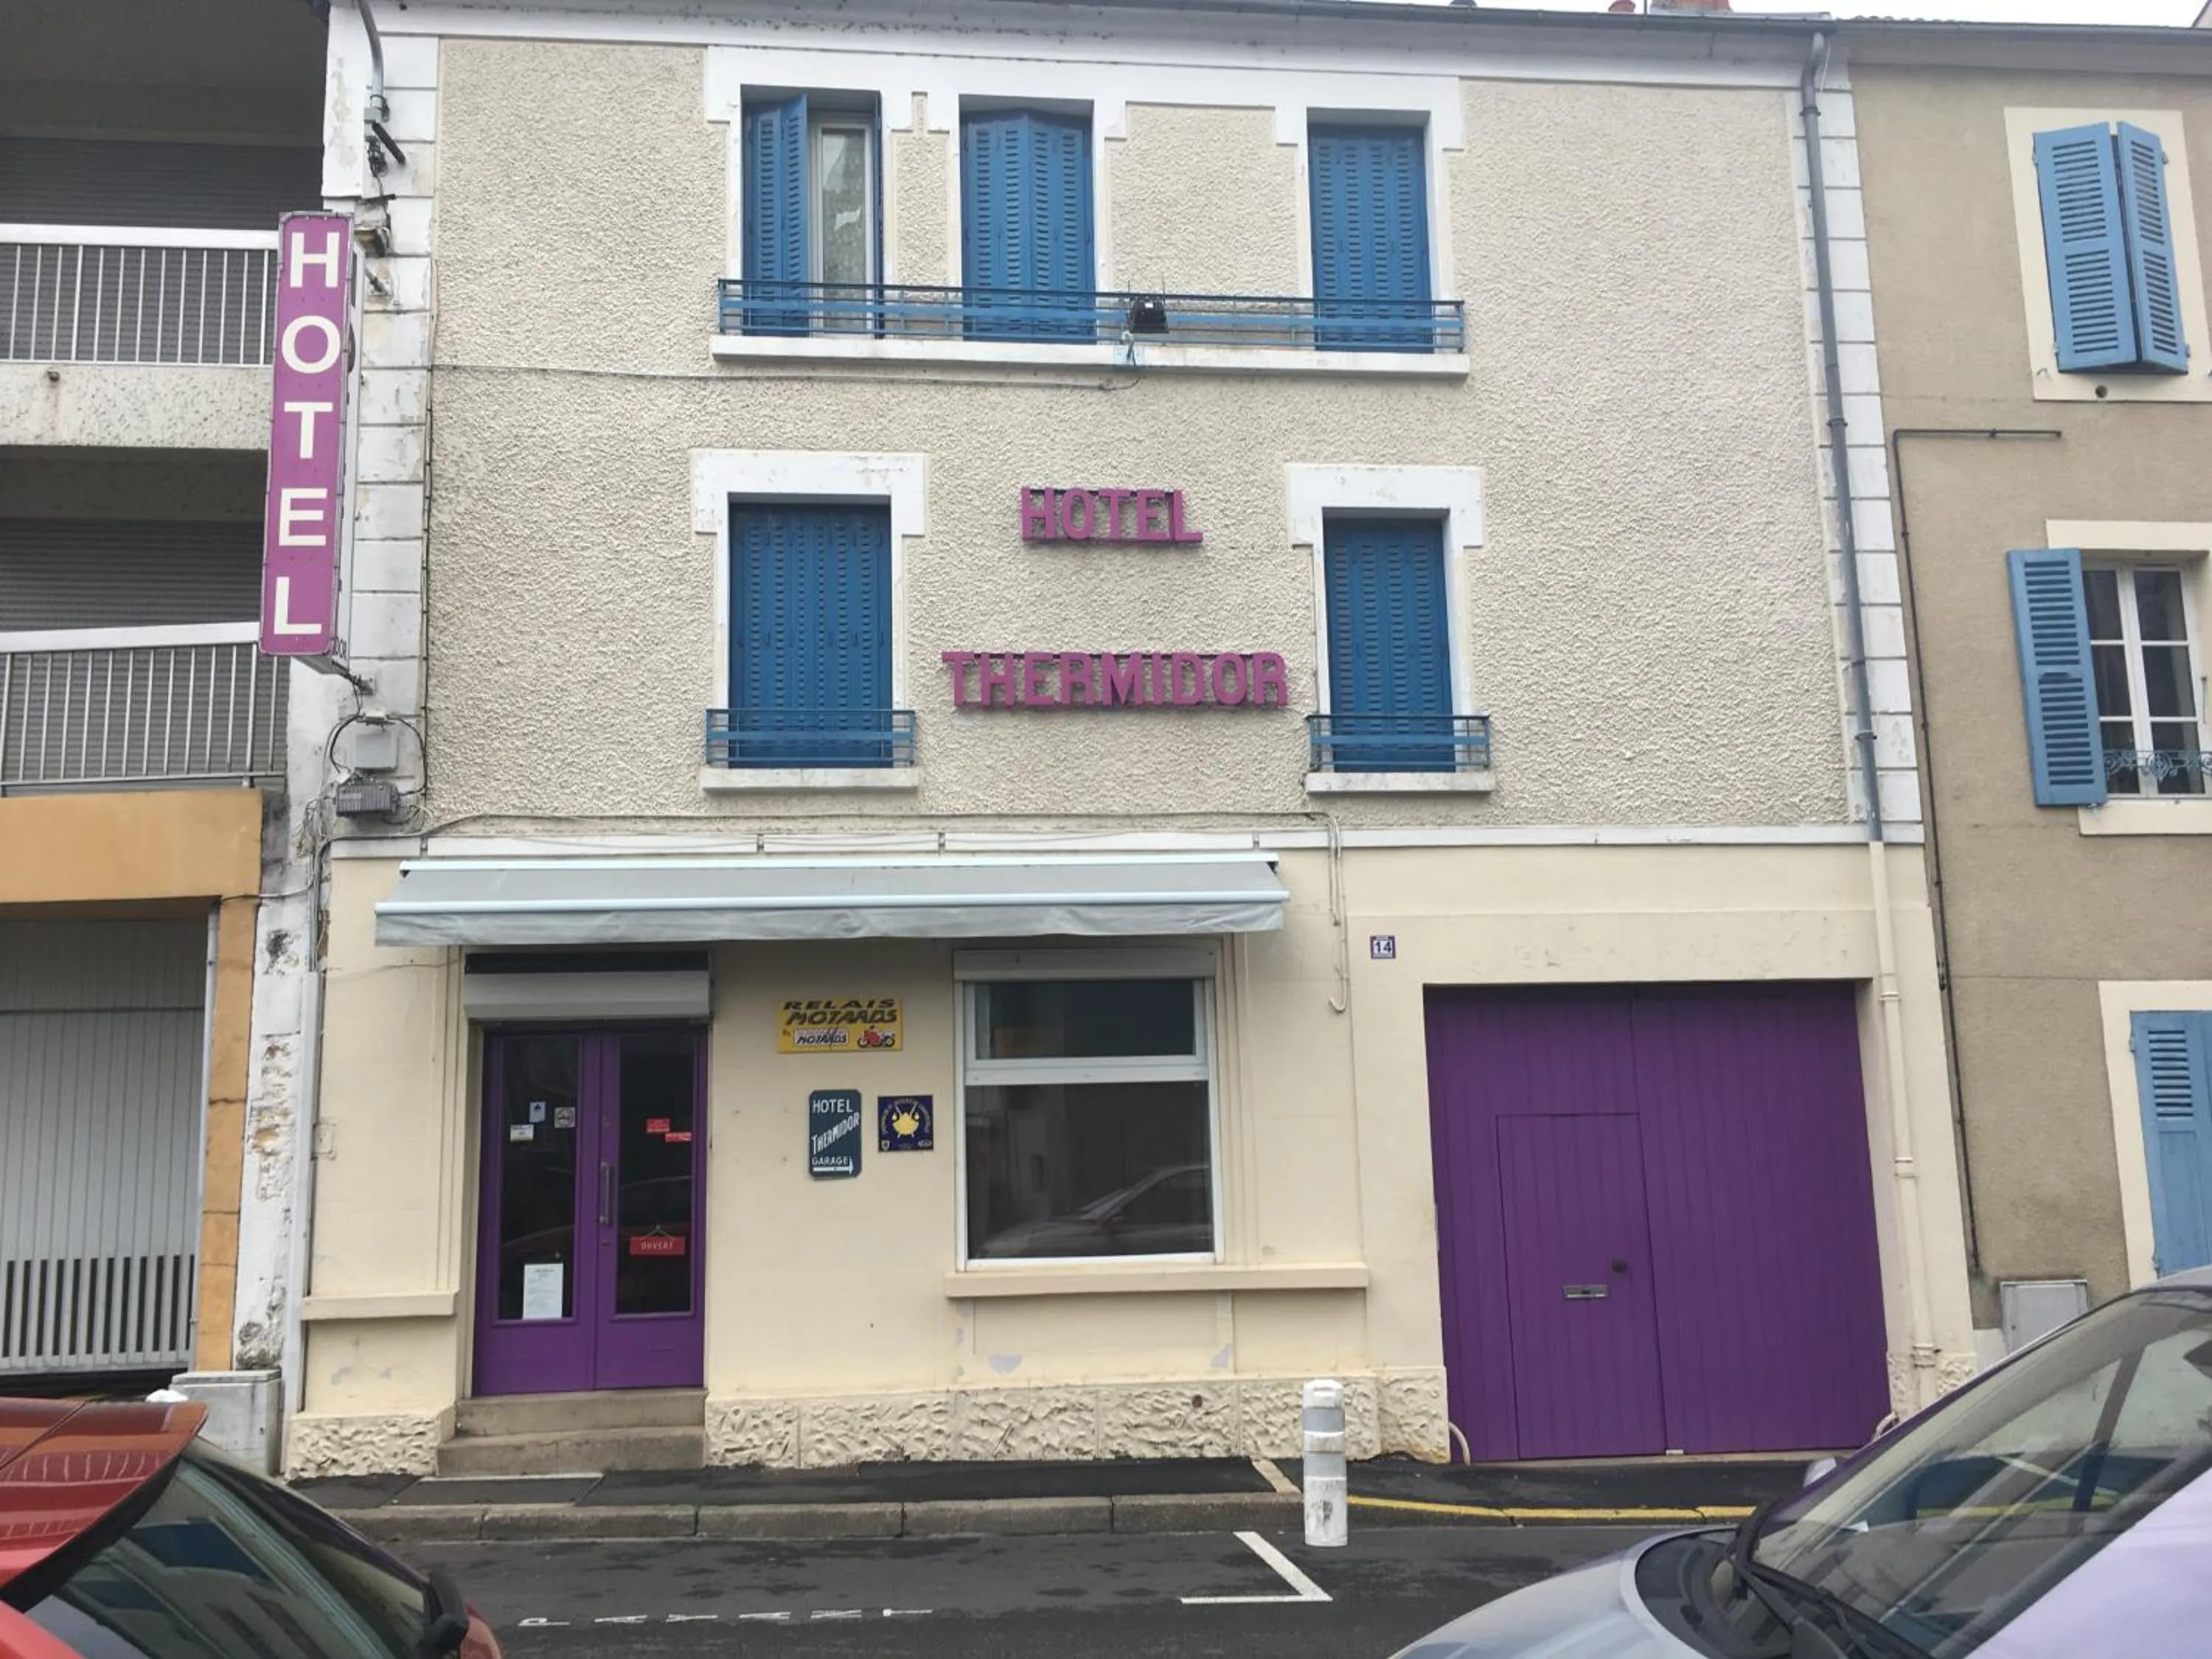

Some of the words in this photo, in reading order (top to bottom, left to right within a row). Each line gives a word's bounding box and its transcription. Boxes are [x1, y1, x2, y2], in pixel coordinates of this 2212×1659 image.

[274, 232, 341, 635] HOTEL
[1020, 487, 1203, 543] HOTEL
[942, 651, 1288, 707] THERMIDOR
[1375, 942, 1391, 953] 14
[783, 998, 895, 1010] RELAIS
[813, 1098, 853, 1113] HOTEL
[811, 1111, 860, 1155] THERMIDOR
[812, 1155, 848, 1166] GARAGE
[640, 1240, 673, 1250] OUVERT
